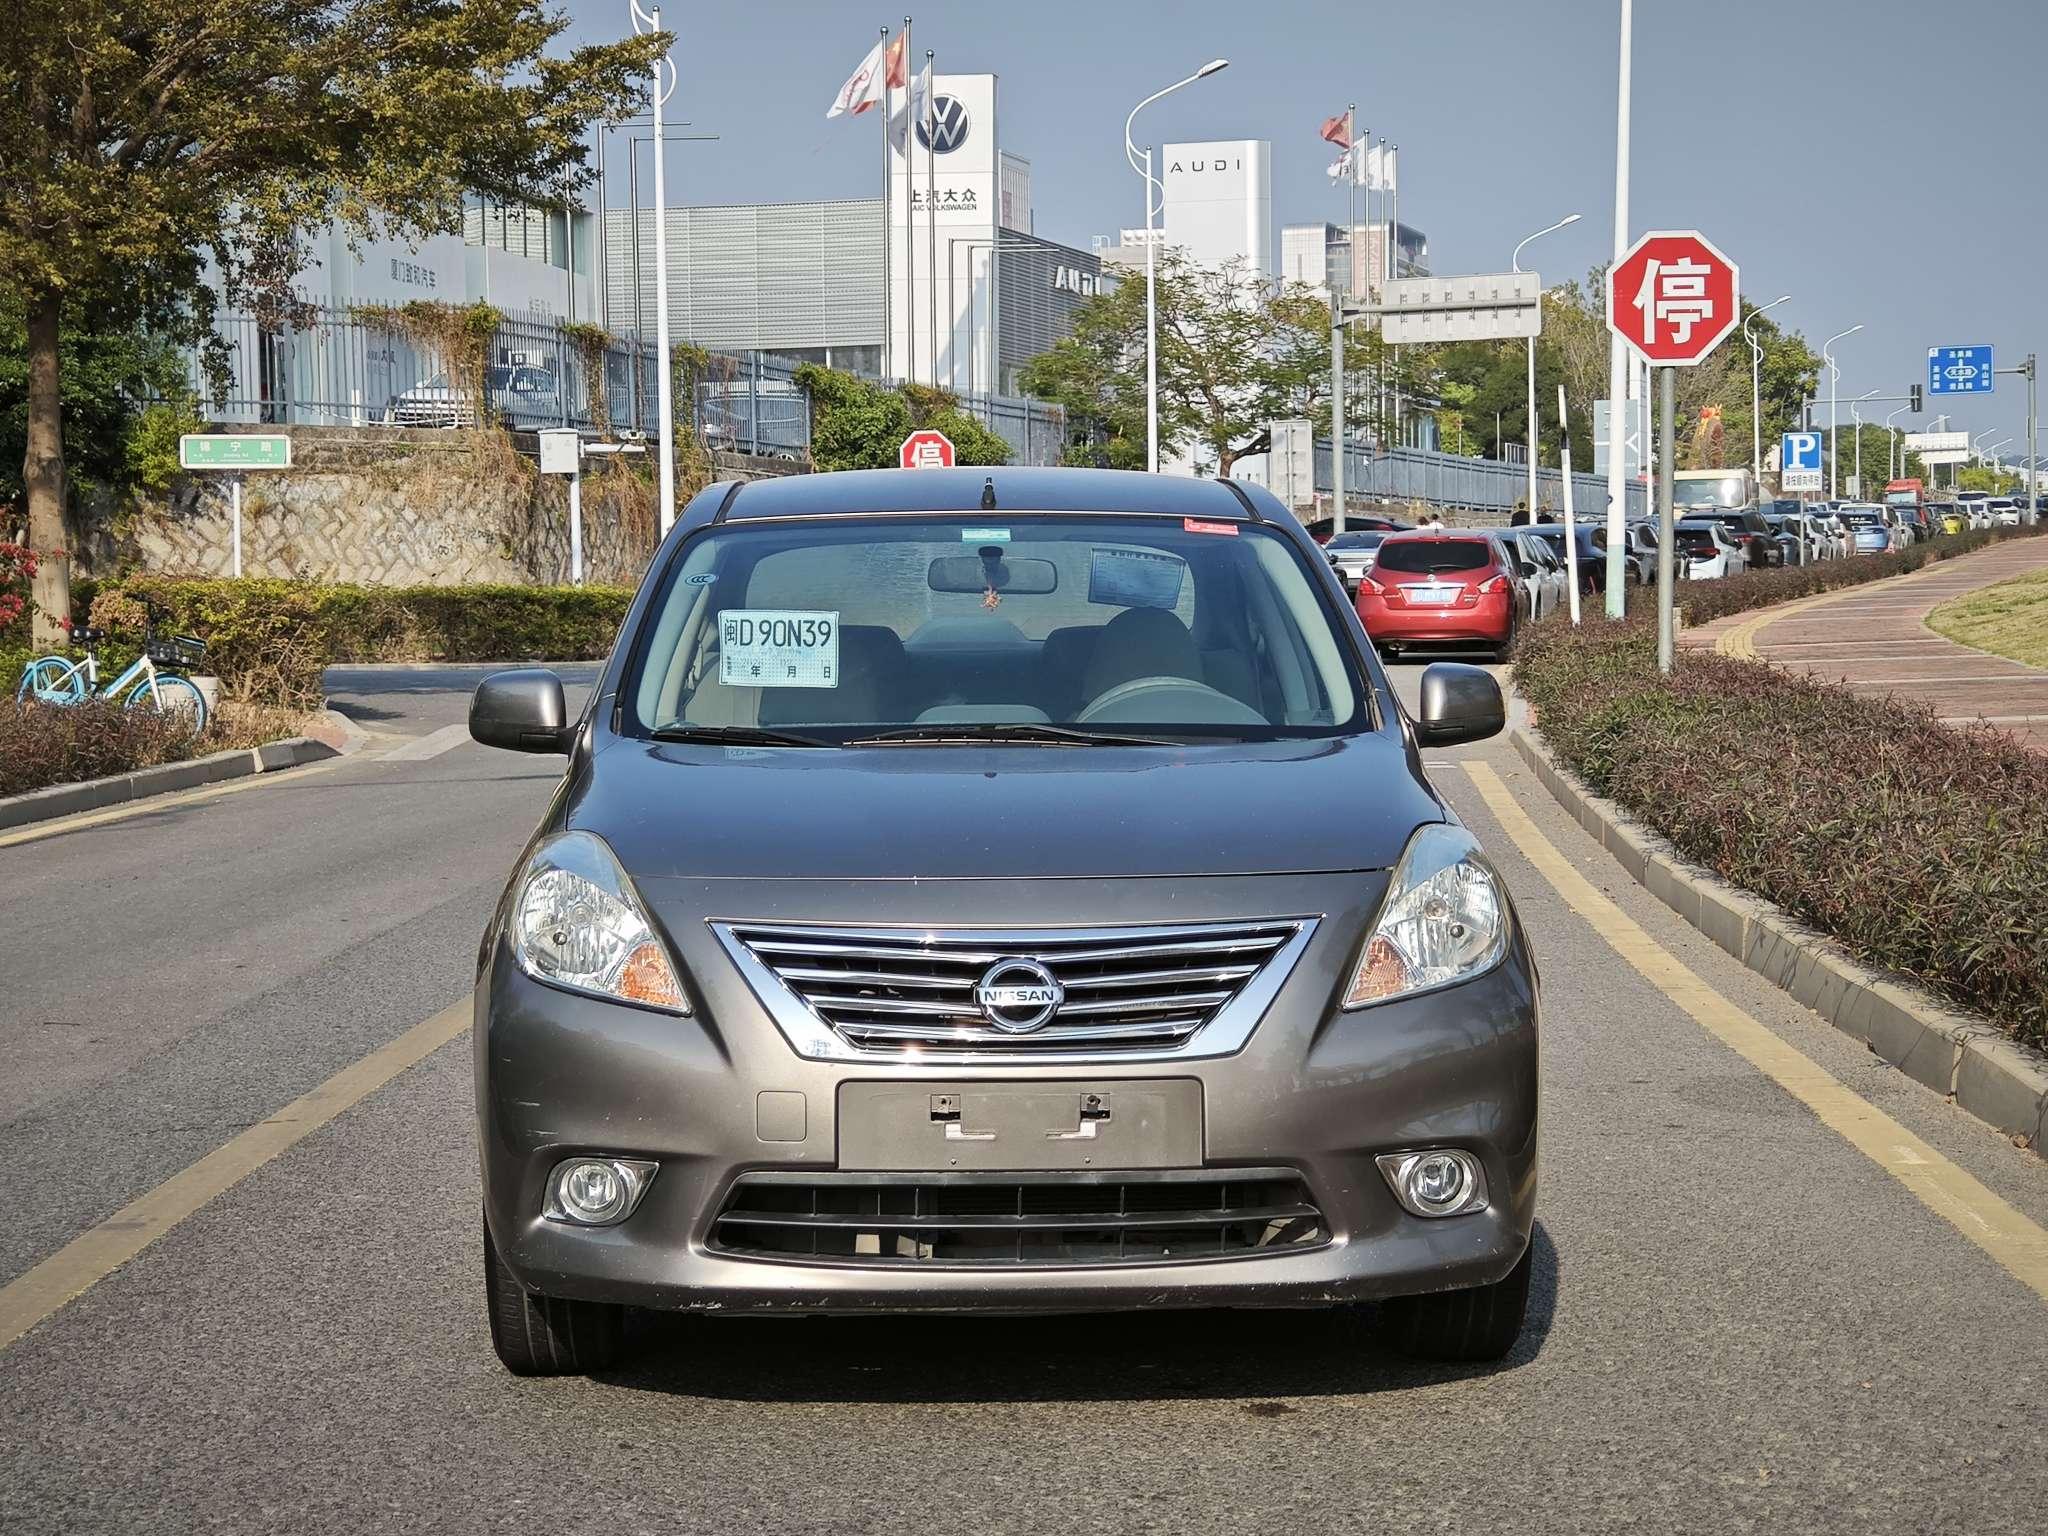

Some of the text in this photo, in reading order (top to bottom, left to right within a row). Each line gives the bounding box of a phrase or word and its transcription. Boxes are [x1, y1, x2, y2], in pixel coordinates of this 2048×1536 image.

[1170, 159, 1240, 173] AUDI
[910, 188, 977, 203] 上汽大众
[908, 204, 925, 212] AIC
[1054, 265, 1101, 297] AUDI
[1632, 256, 1713, 344] 停
[1787, 434, 1816, 468] P
[750, 665, 831, 679] 年 月 日
[984, 990, 1054, 1002] NISSAN
